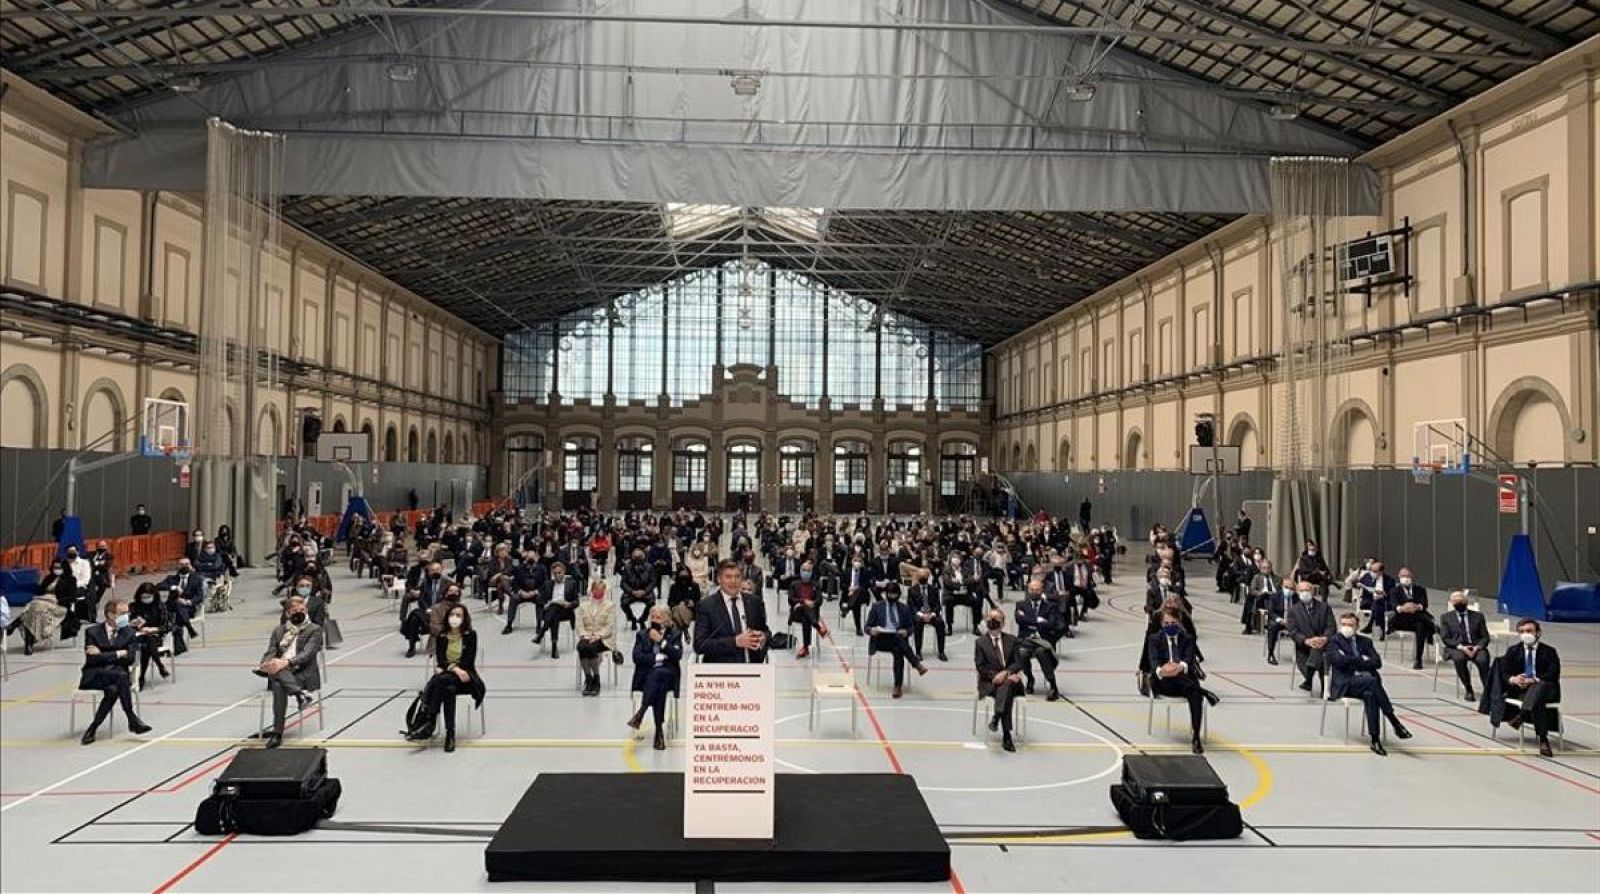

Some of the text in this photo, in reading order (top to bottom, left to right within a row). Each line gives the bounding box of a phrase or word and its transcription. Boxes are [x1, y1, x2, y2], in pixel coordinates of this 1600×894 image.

[694, 681, 741, 689] JA N'HI HA
[693, 714, 720, 722] EN LA
[694, 743, 742, 752] YA BASTA,
